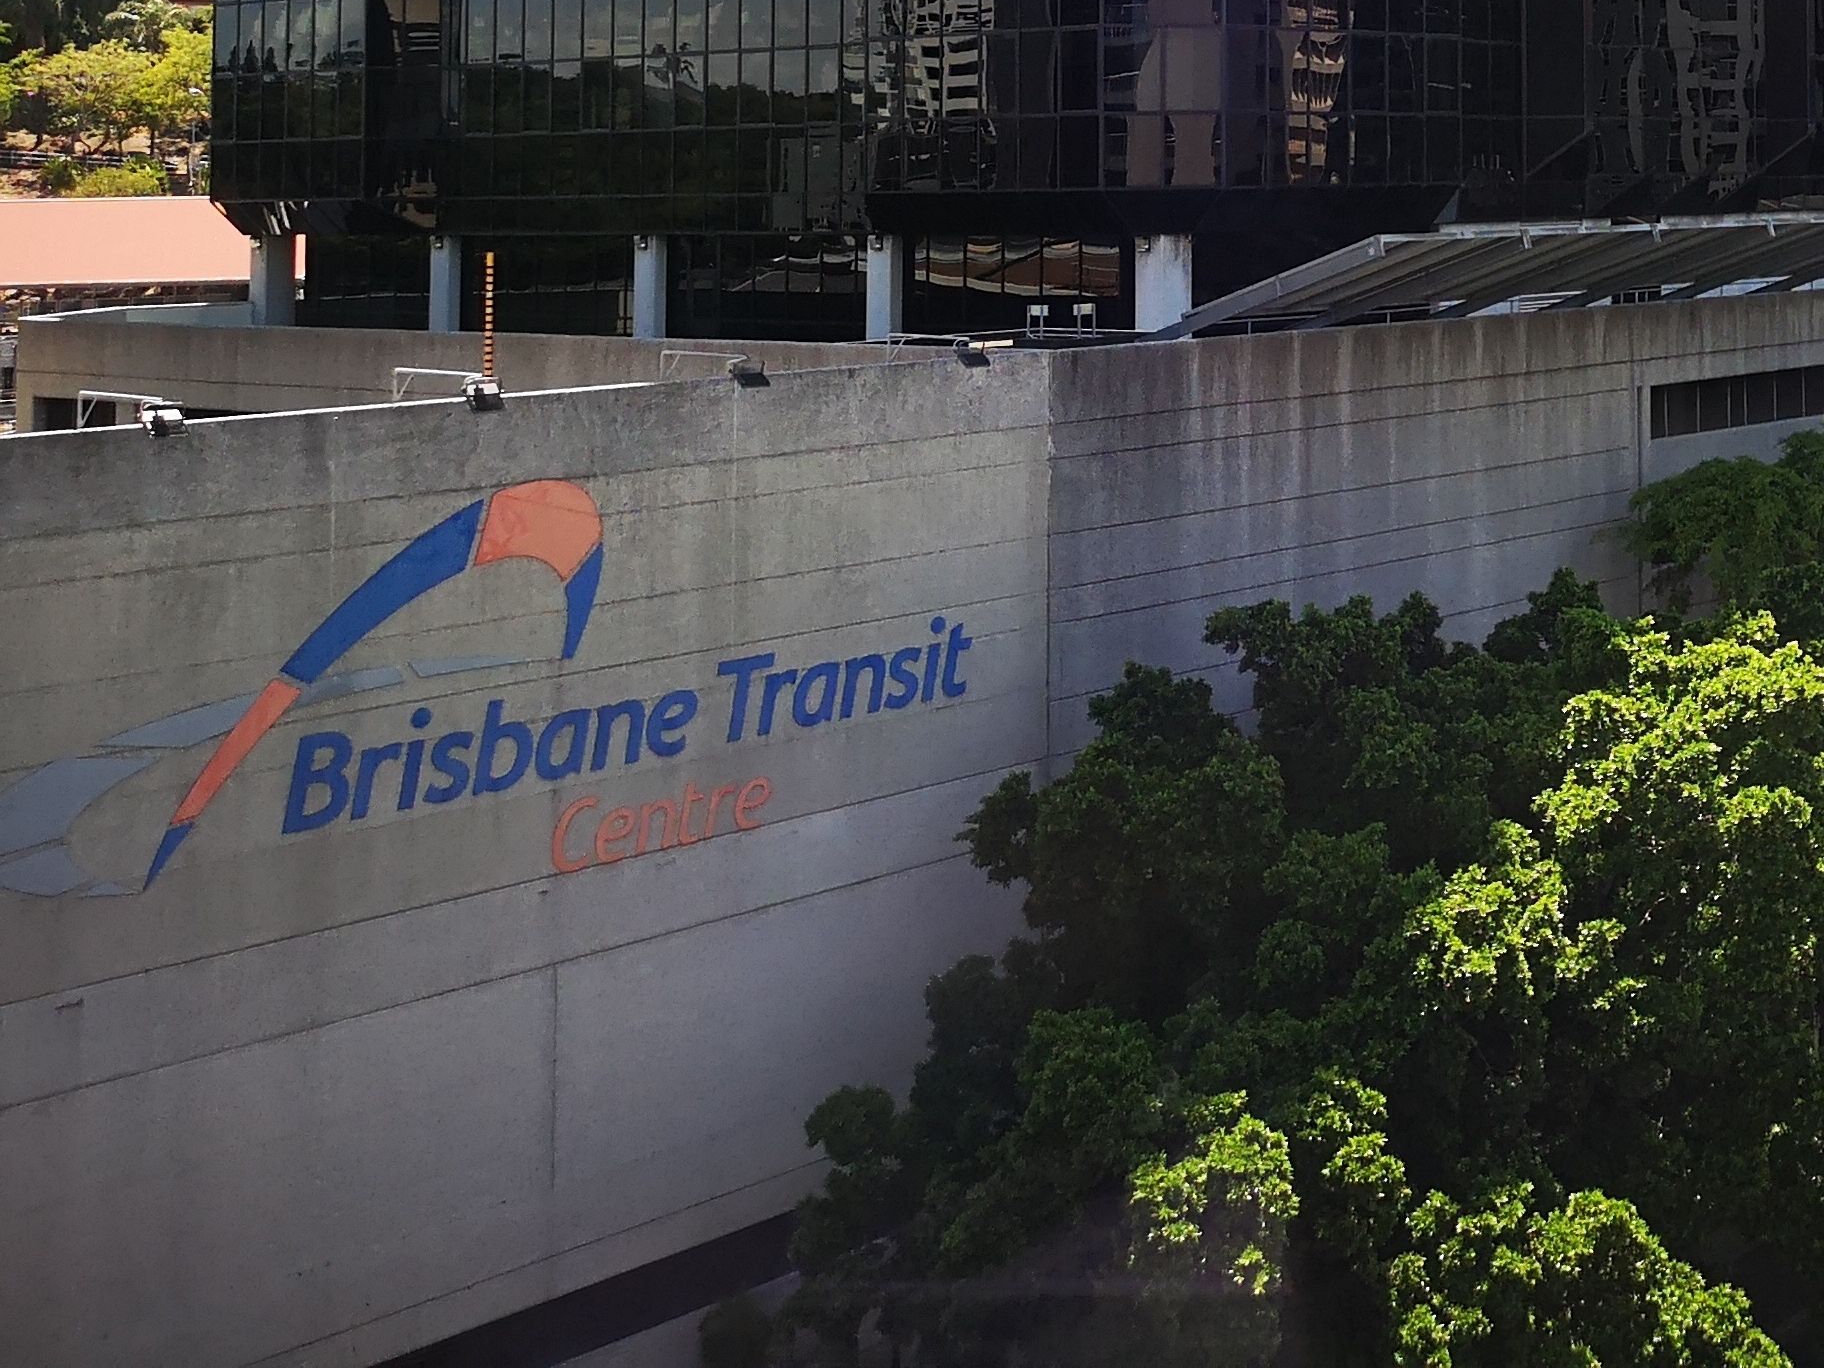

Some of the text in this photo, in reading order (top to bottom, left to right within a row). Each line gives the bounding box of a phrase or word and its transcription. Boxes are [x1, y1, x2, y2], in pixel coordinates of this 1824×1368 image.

[280, 615, 973, 836] Brisbane Transit
[551, 776, 774, 874] Centre
